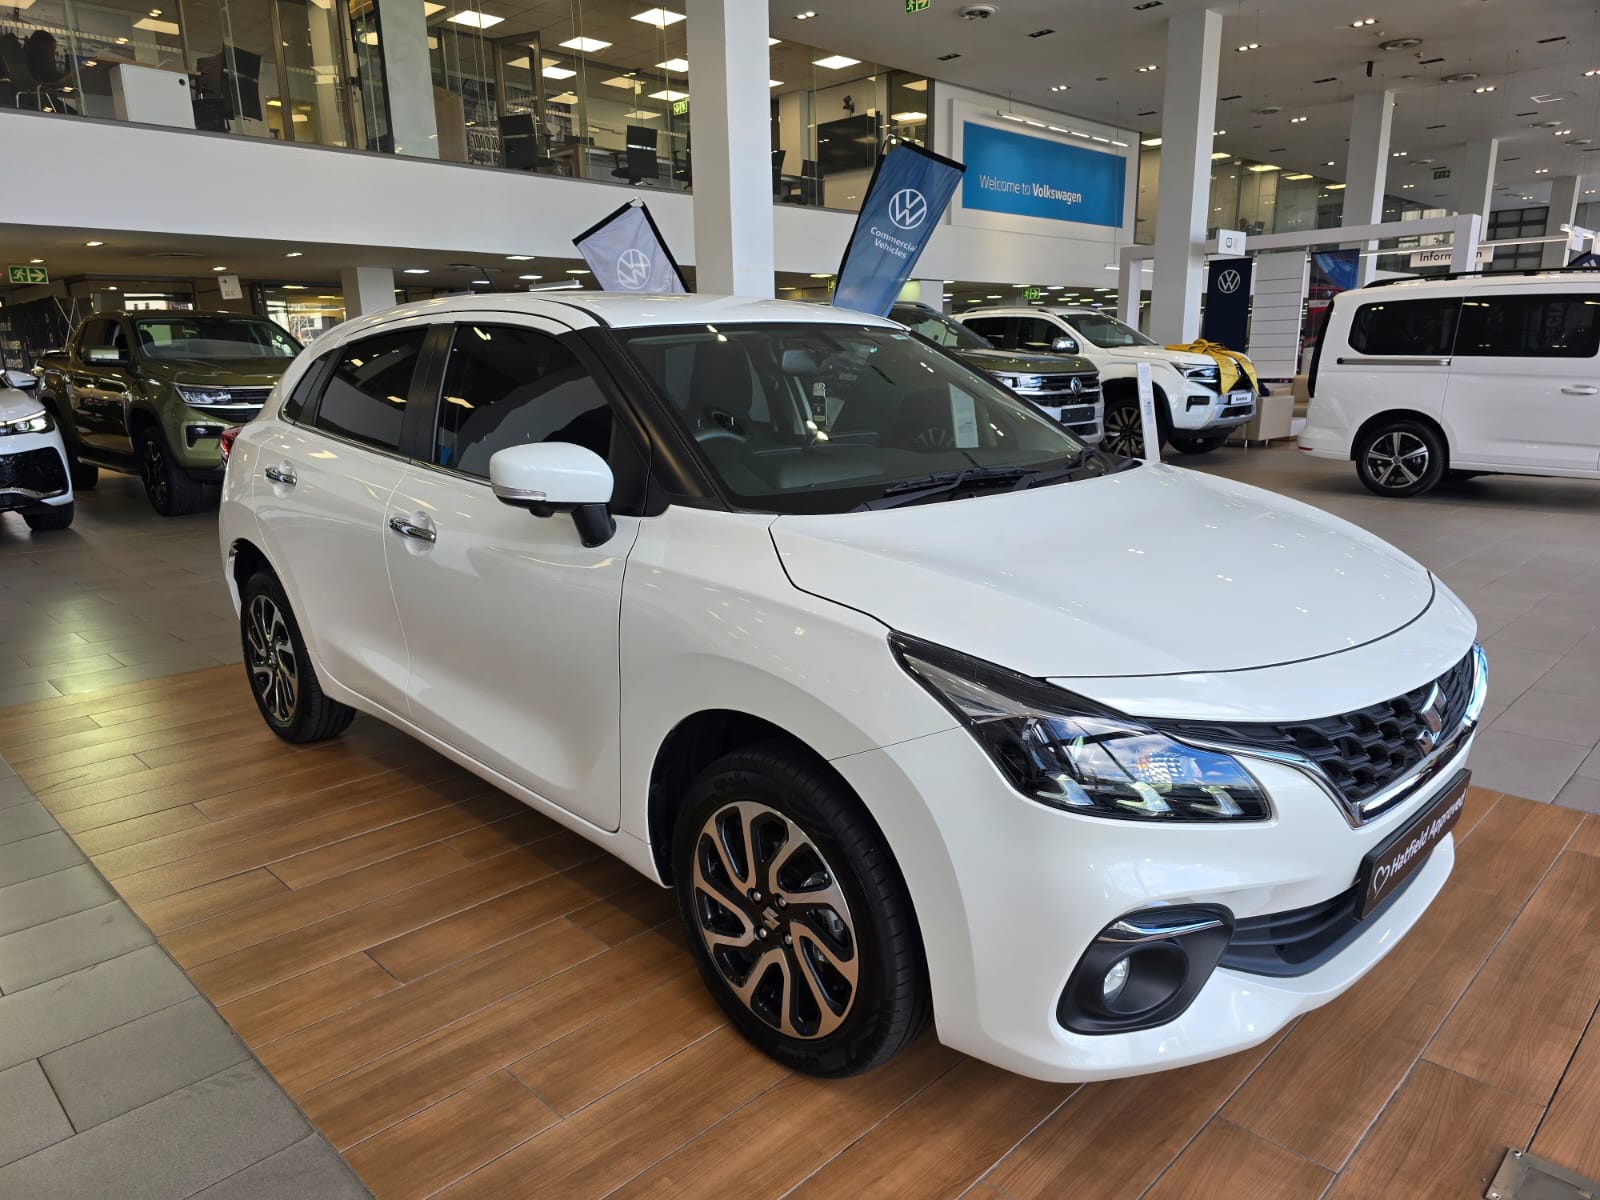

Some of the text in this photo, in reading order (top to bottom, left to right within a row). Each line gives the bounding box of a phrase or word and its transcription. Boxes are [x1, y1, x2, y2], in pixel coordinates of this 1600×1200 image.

[979, 174, 1082, 205] Welcome to Volkswagen
[874, 238, 908, 259] Vehicles
[1390, 787, 1468, 877] Hatfield Approved
